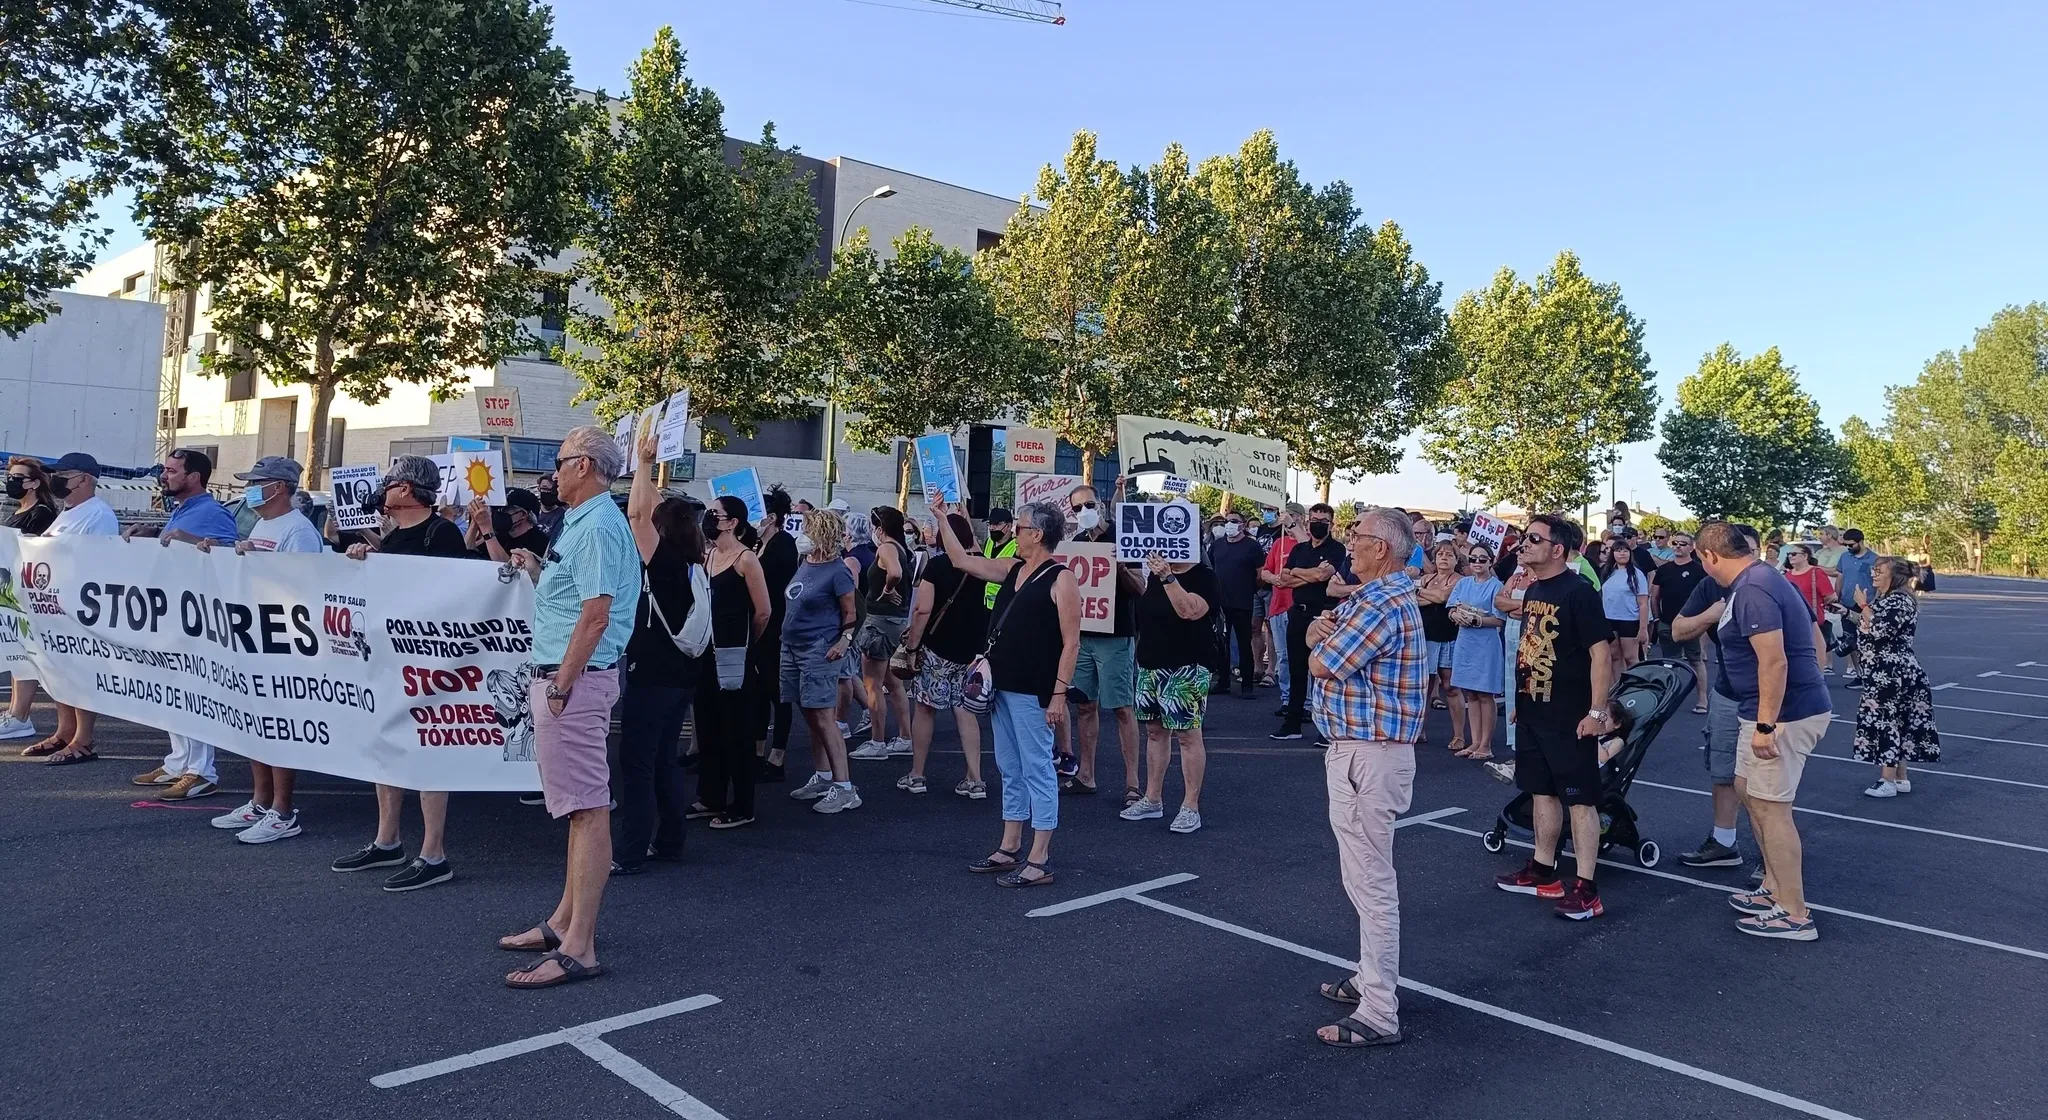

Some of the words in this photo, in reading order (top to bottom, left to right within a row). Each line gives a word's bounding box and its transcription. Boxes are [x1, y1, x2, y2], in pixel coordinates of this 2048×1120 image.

[485, 397, 510, 410] STOP
[486, 417, 514, 427] OLORES
[1016, 441, 1044, 450] FUERA
[1253, 450, 1281, 463] STOP
[1013, 454, 1046, 463] OLORES
[1249, 464, 1283, 481] OLORE
[334, 479, 372, 506] NO
[1019, 474, 1072, 504] Fuera
[1164, 480, 1187, 488] OLORES
[785, 518, 804, 531] ST
[1122, 504, 1191, 535] NO
[1120, 536, 1190, 549] OLORES
[324, 593, 337, 603] POR
[339, 595, 346, 604] TU
[348, 596, 366, 607] SALUD
[76, 582, 168, 633] STOP
[180, 590, 319, 657] OLORES
[323, 605, 351, 639] NO
[386, 618, 418, 636] POR
[417, 620, 441, 637] LA
[441, 619, 504, 639] SALUD
[505, 617, 532, 635] DE
[391, 637, 480, 658] NUESTROS
[479, 636, 533, 653] HIJOS
[1529, 613, 1560, 702] CASH
[40, 630, 111, 659] FÁBRICAS
[111, 643, 133, 662] DE
[134, 648, 211, 684] BIOMETANO,
[211, 660, 249, 696] BIOGÁS
[252, 674, 267, 698] E
[271, 673, 375, 714] HIDRÓGENO
[402, 665, 484, 697] STOP
[96, 672, 162, 704] ALEJADAS
[166, 686, 182, 709] DE
[184, 690, 243, 731] NUESTROS
[244, 712, 330, 745] PUEBLOS
[409, 704, 499, 724] OLORES
[417, 724, 505, 746] TÓXICOS
